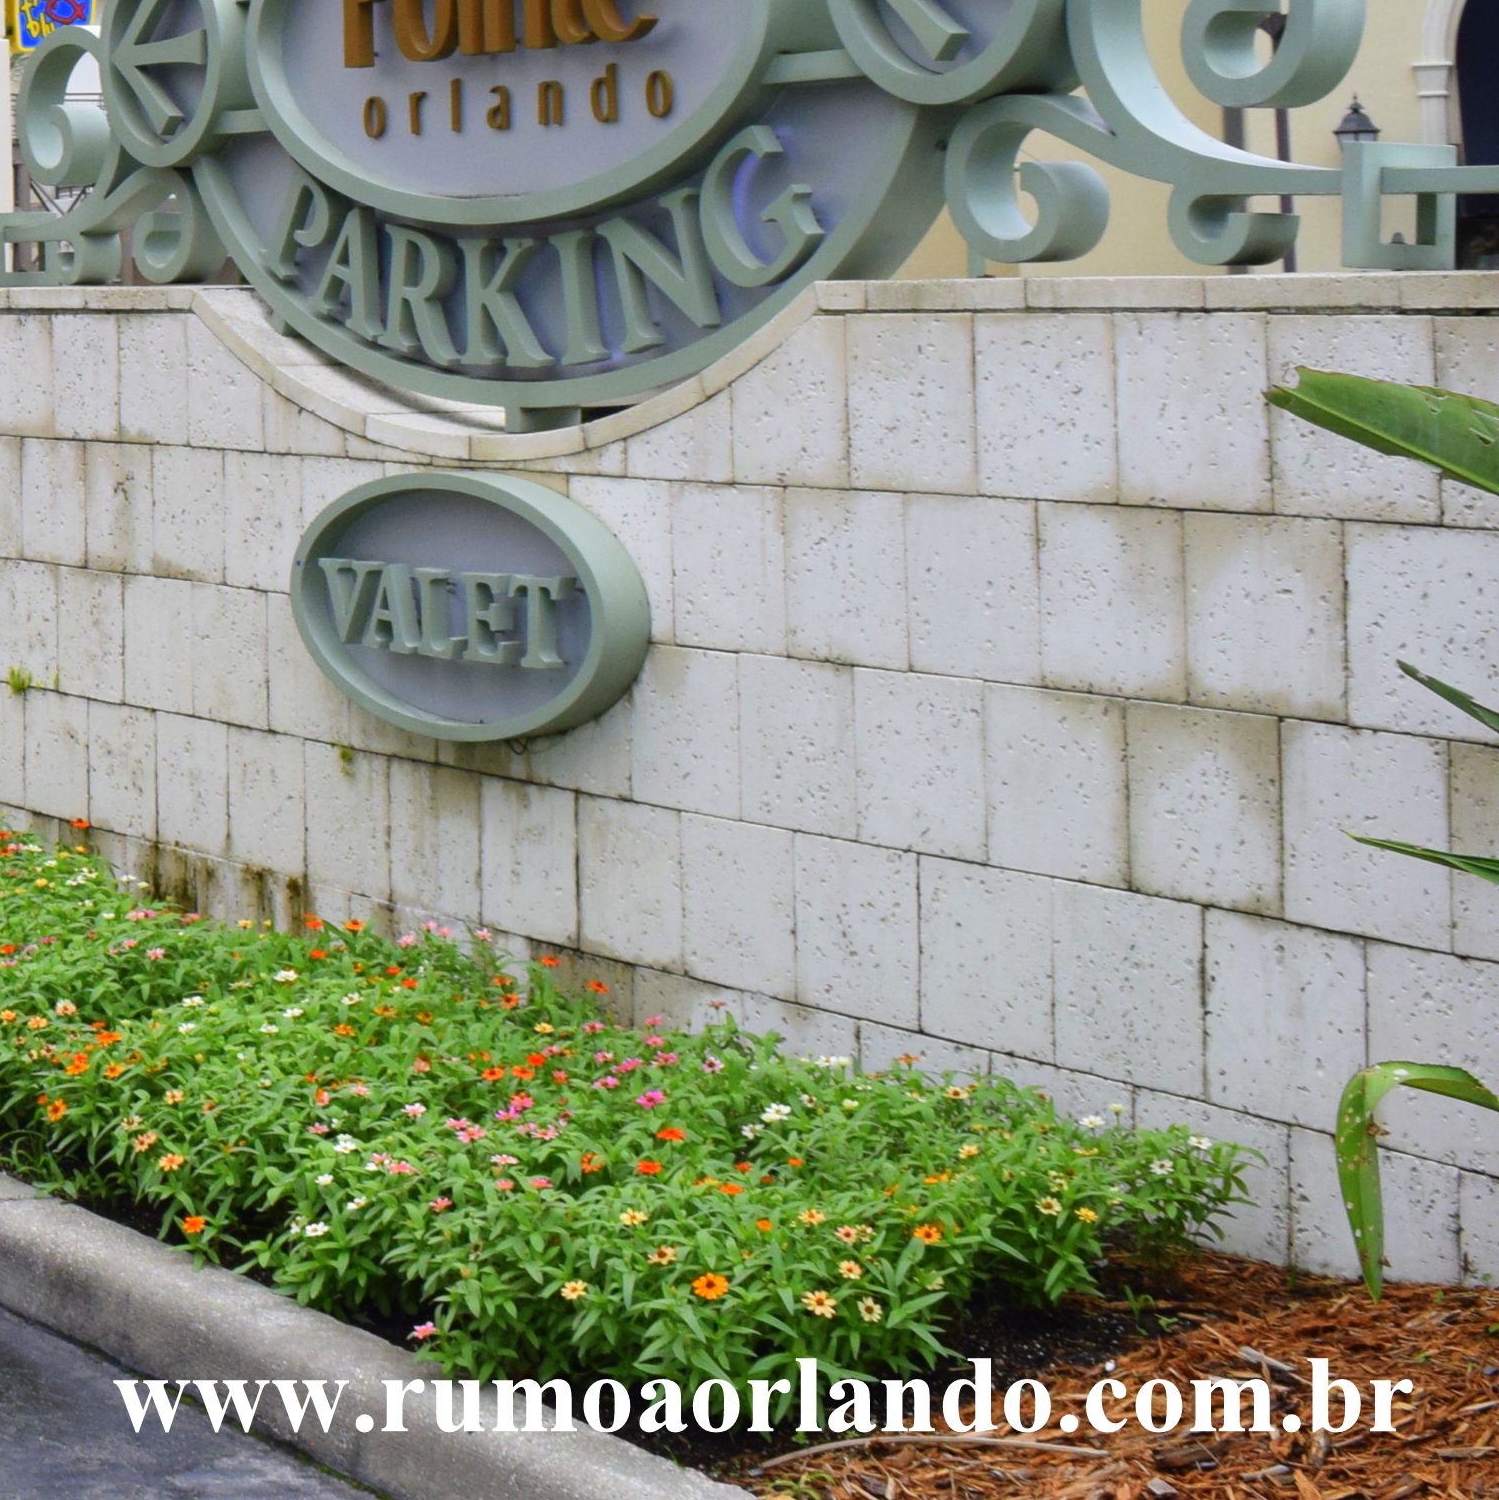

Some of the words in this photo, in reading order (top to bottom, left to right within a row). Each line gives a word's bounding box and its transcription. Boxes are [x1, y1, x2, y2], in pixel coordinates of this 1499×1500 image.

[362, 62, 674, 141] orlando
[260, 125, 826, 368] PARKING
[317, 556, 579, 669] VALET
